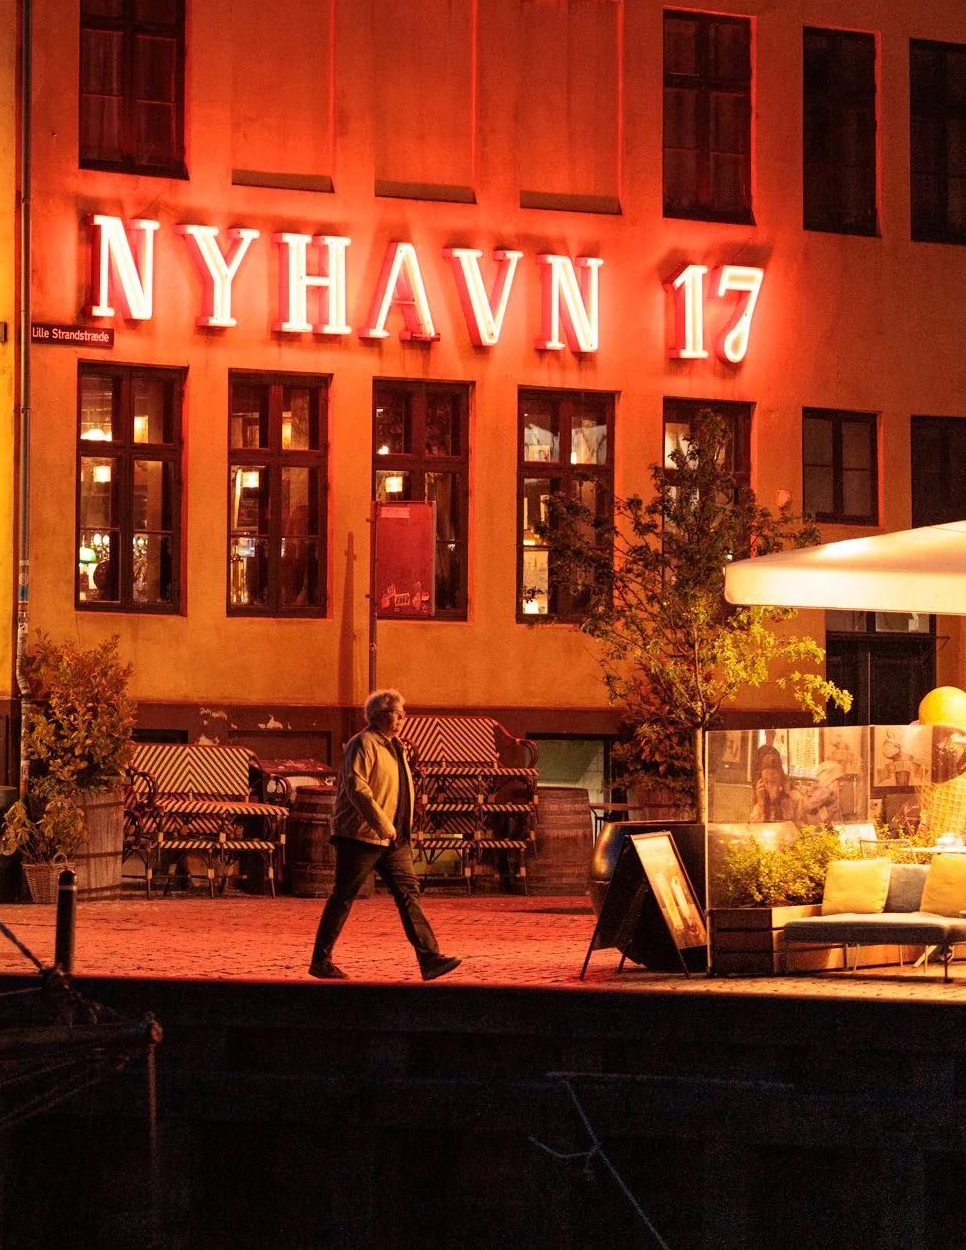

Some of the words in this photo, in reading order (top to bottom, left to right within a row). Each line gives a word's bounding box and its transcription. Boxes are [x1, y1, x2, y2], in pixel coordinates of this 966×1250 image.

[89, 214, 605, 353] NYHAVN
[666, 264, 764, 363] 17
[32, 327, 49, 338] Lille
[52, 328, 110, 342] Strandstræde
